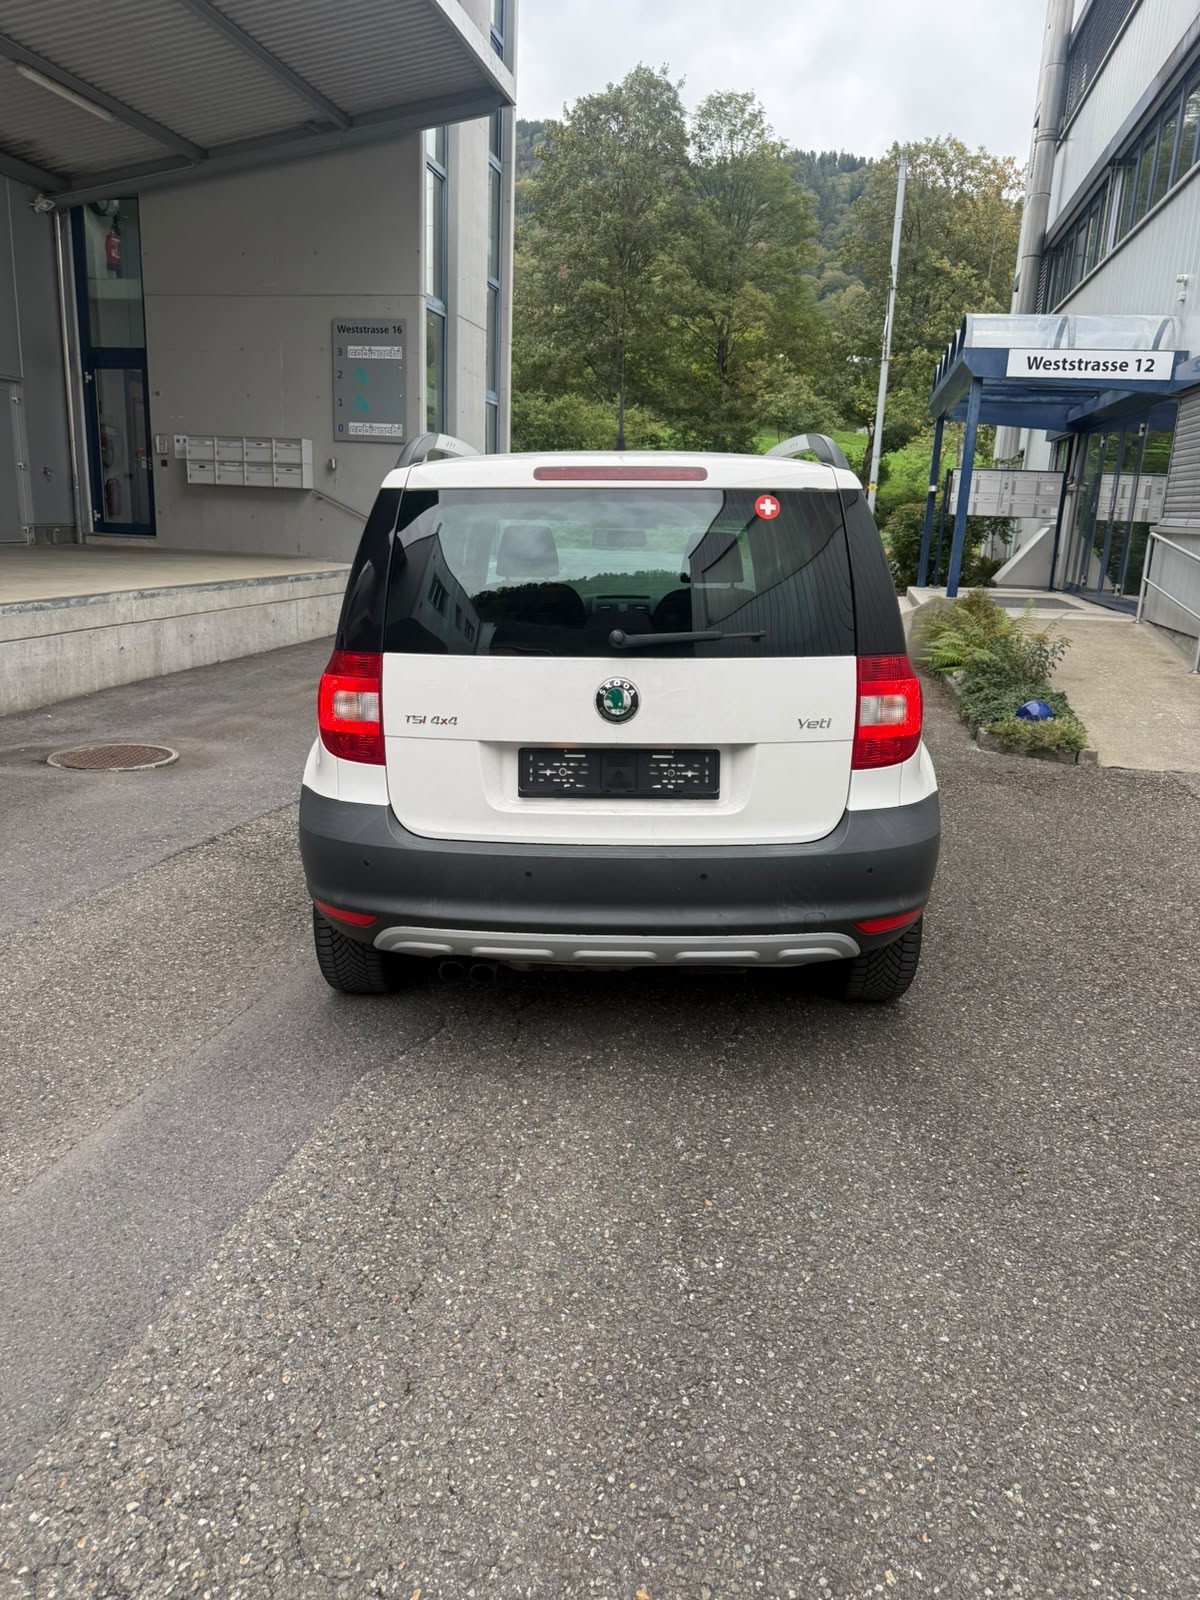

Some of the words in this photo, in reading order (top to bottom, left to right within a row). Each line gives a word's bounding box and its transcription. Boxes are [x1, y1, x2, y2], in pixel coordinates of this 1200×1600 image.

[336, 324, 390, 334] Weststrasse
[392, 325, 403, 334] 16
[336, 347, 343, 356] 3
[1027, 356, 1129, 372] Weststrasse
[1135, 358, 1155, 372] 12
[337, 369, 343, 379] 2
[337, 398, 343, 407] 1
[338, 424, 344, 432] 0
[405, 715, 427, 724] TSI
[430, 715, 458, 726] 4x4
[797, 717, 832, 730] Yeti
